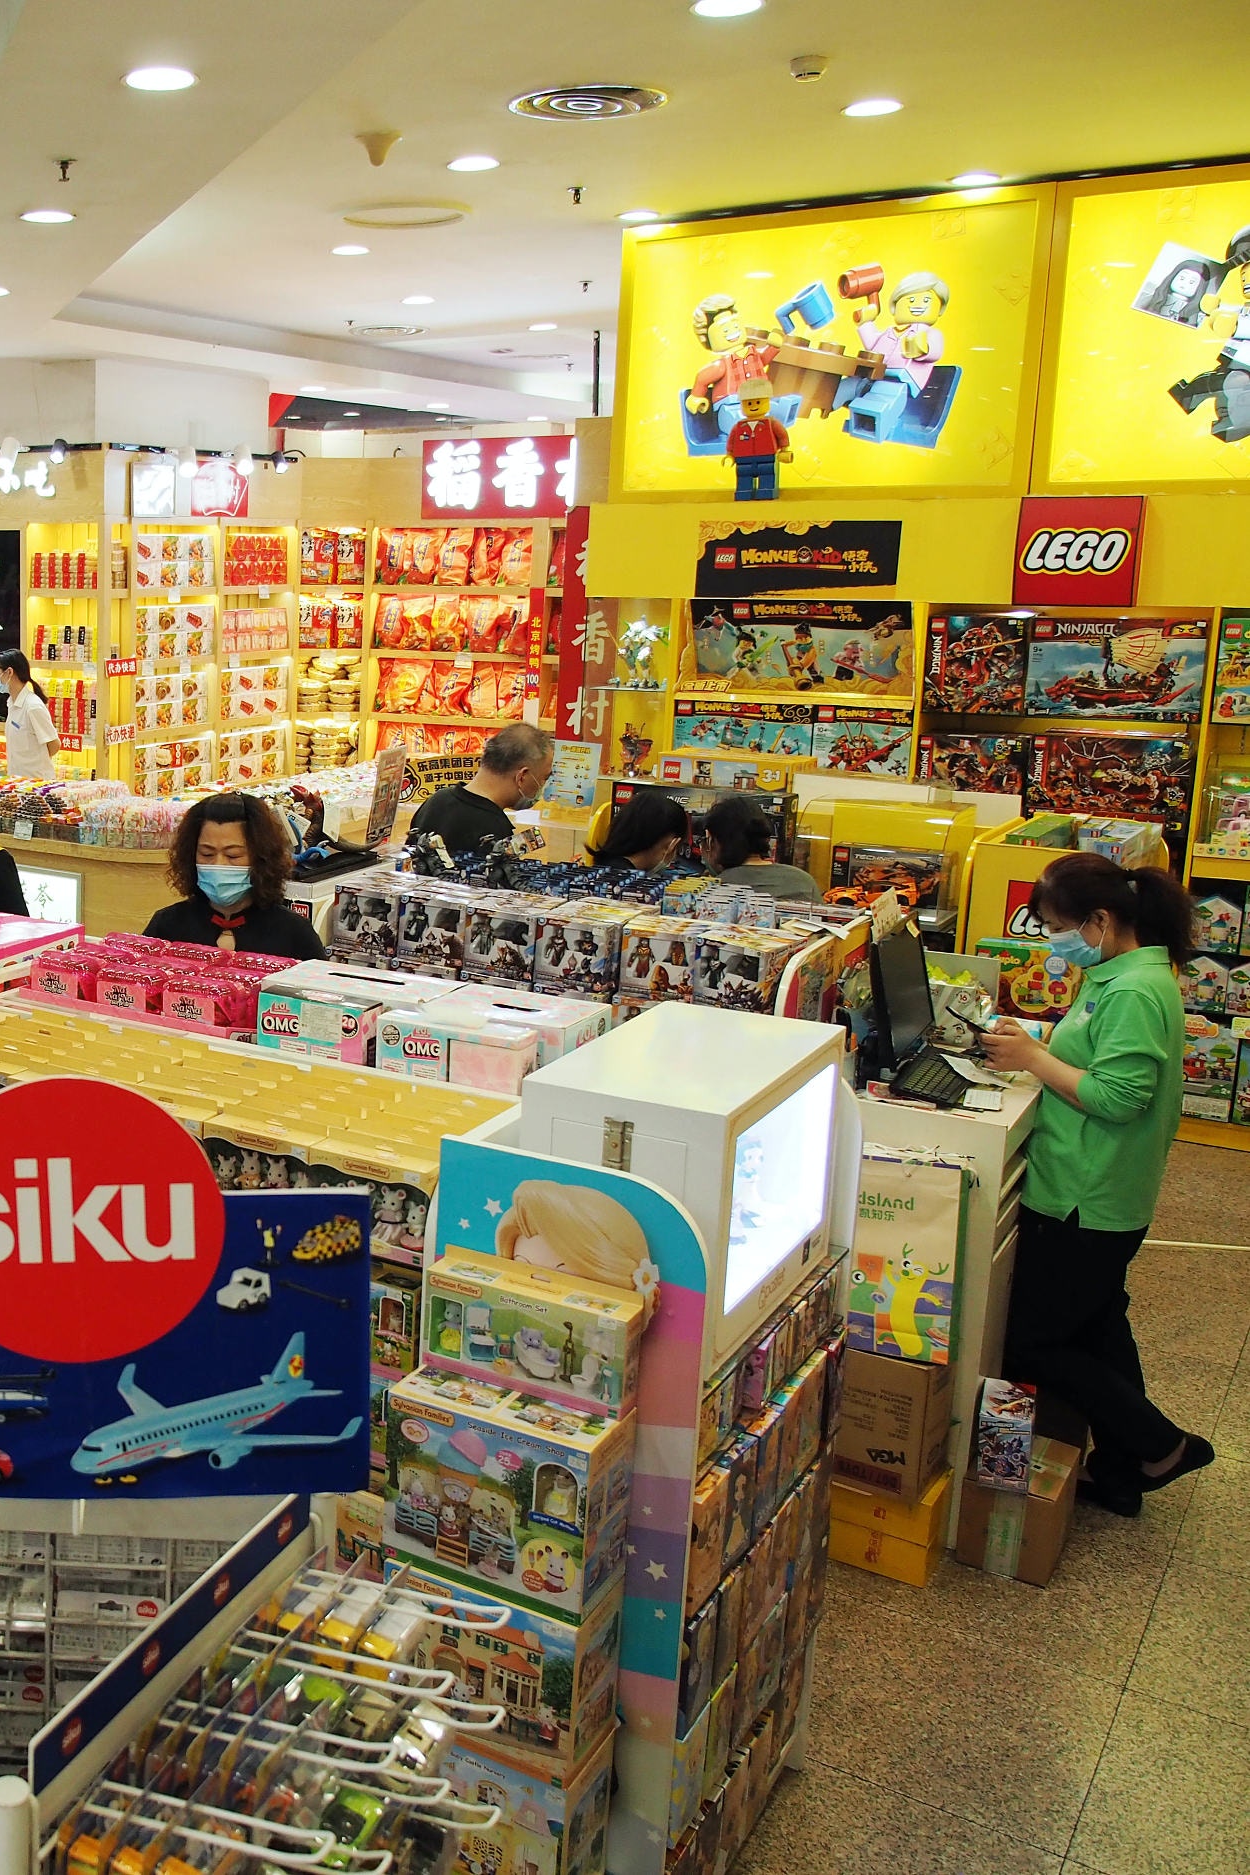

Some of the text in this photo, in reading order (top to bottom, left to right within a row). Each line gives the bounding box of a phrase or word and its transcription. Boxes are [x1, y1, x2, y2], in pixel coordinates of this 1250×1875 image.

[716, 553, 736, 563] LEGO
[1023, 528, 1131, 574] LEGO
[423, 771, 478, 783] 源于中国经
[1010, 907, 1050, 938] LE
[262, 1016, 300, 1035] OMG
[404, 1040, 441, 1057] OMG
[431, 1276, 481, 1297] Sylvanian Families
[499, 1294, 549, 1315] Bathroom Set
[392, 1398, 452, 1425] Sylvanian Families
[466, 1420, 566, 1459] Seaside Ice Cream Shop
[497, 1454, 511, 1465] 25
[866, 1447, 906, 1466] MGA
[422, 1582, 450, 1599] Families
